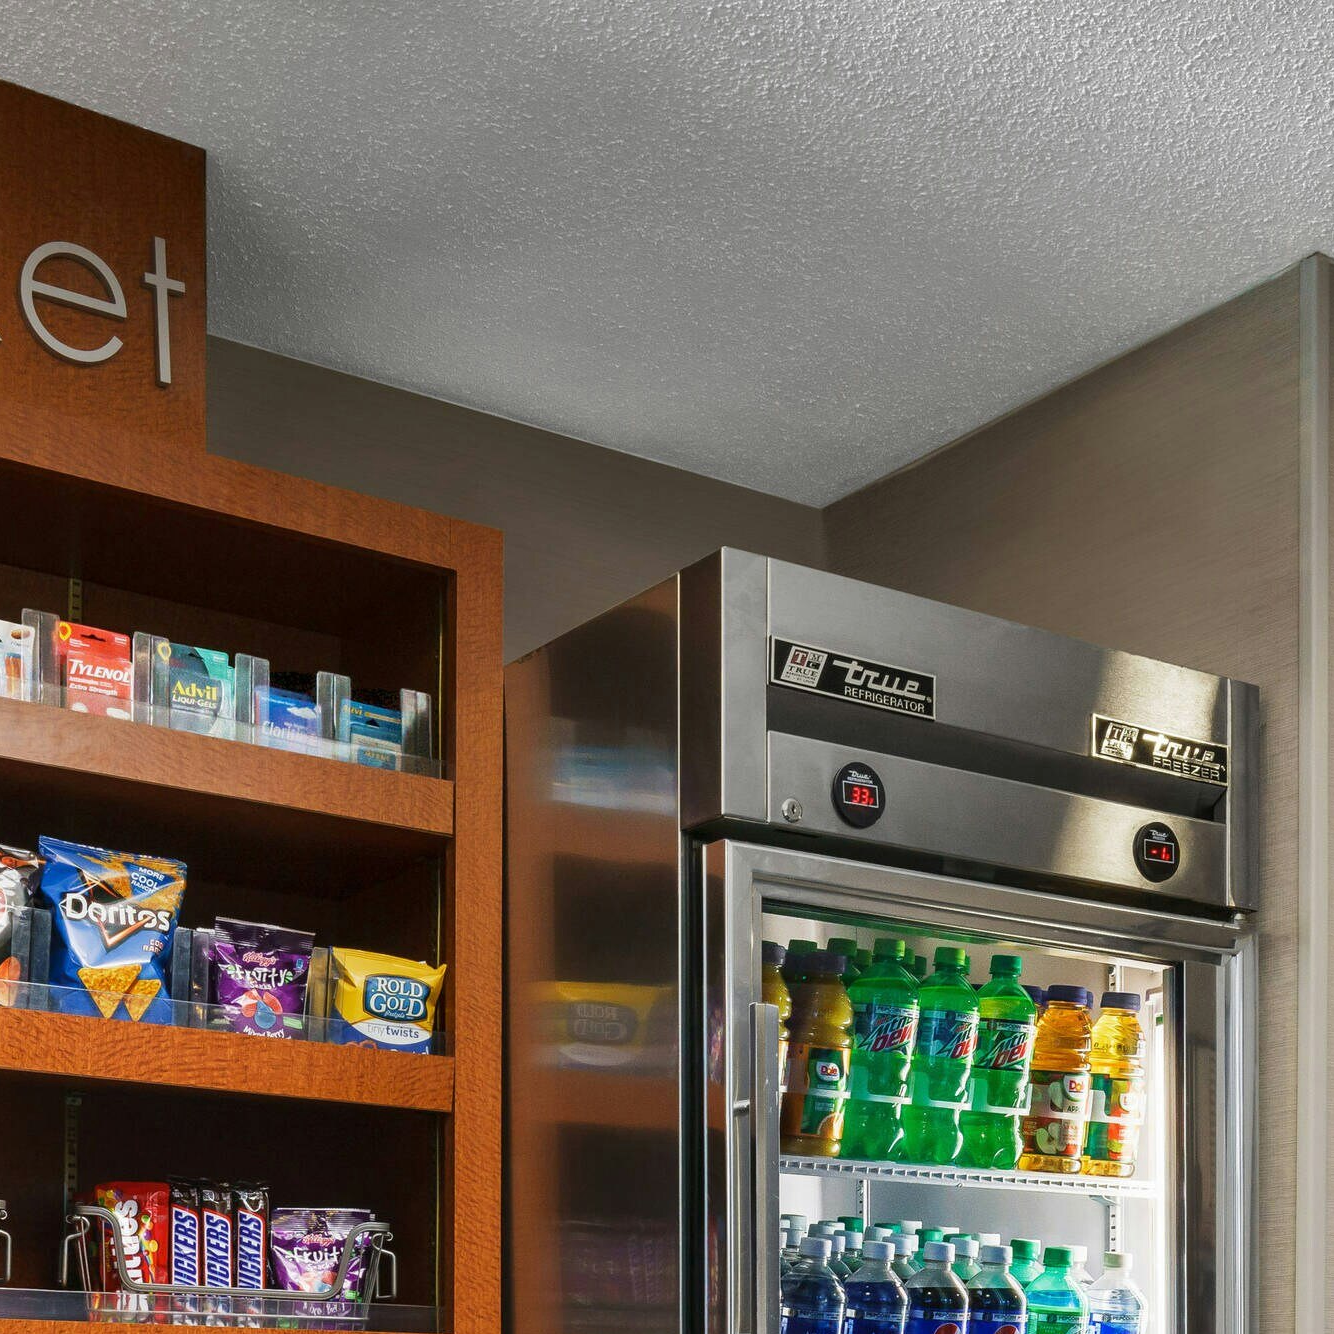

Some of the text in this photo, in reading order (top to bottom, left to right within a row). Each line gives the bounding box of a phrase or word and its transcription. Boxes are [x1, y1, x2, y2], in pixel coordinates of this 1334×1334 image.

[68, 658, 131, 684] TYLENOL
[788, 664, 819, 677] TRUE
[171, 680, 218, 701] Advil
[844, 685, 926, 713] REFRIGERATOR
[172, 695, 218, 710] LIQUI-GELS
[1152, 757, 1220, 780] FREEZER
[131, 872, 159, 890] COOL
[138, 866, 166, 880] MORE
[60, 893, 172, 932] Doritos
[375, 976, 424, 998] ROLD
[369, 992, 425, 1017] GOLD
[386, 1025, 419, 1039] twists
[820, 1065, 838, 1077] Dole
[174, 1210, 198, 1286] ICKERS
[205, 1211, 230, 1288] ICKERS
[239, 1213, 263, 1289] ICKERS
[289, 1246, 344, 1264] fruit
